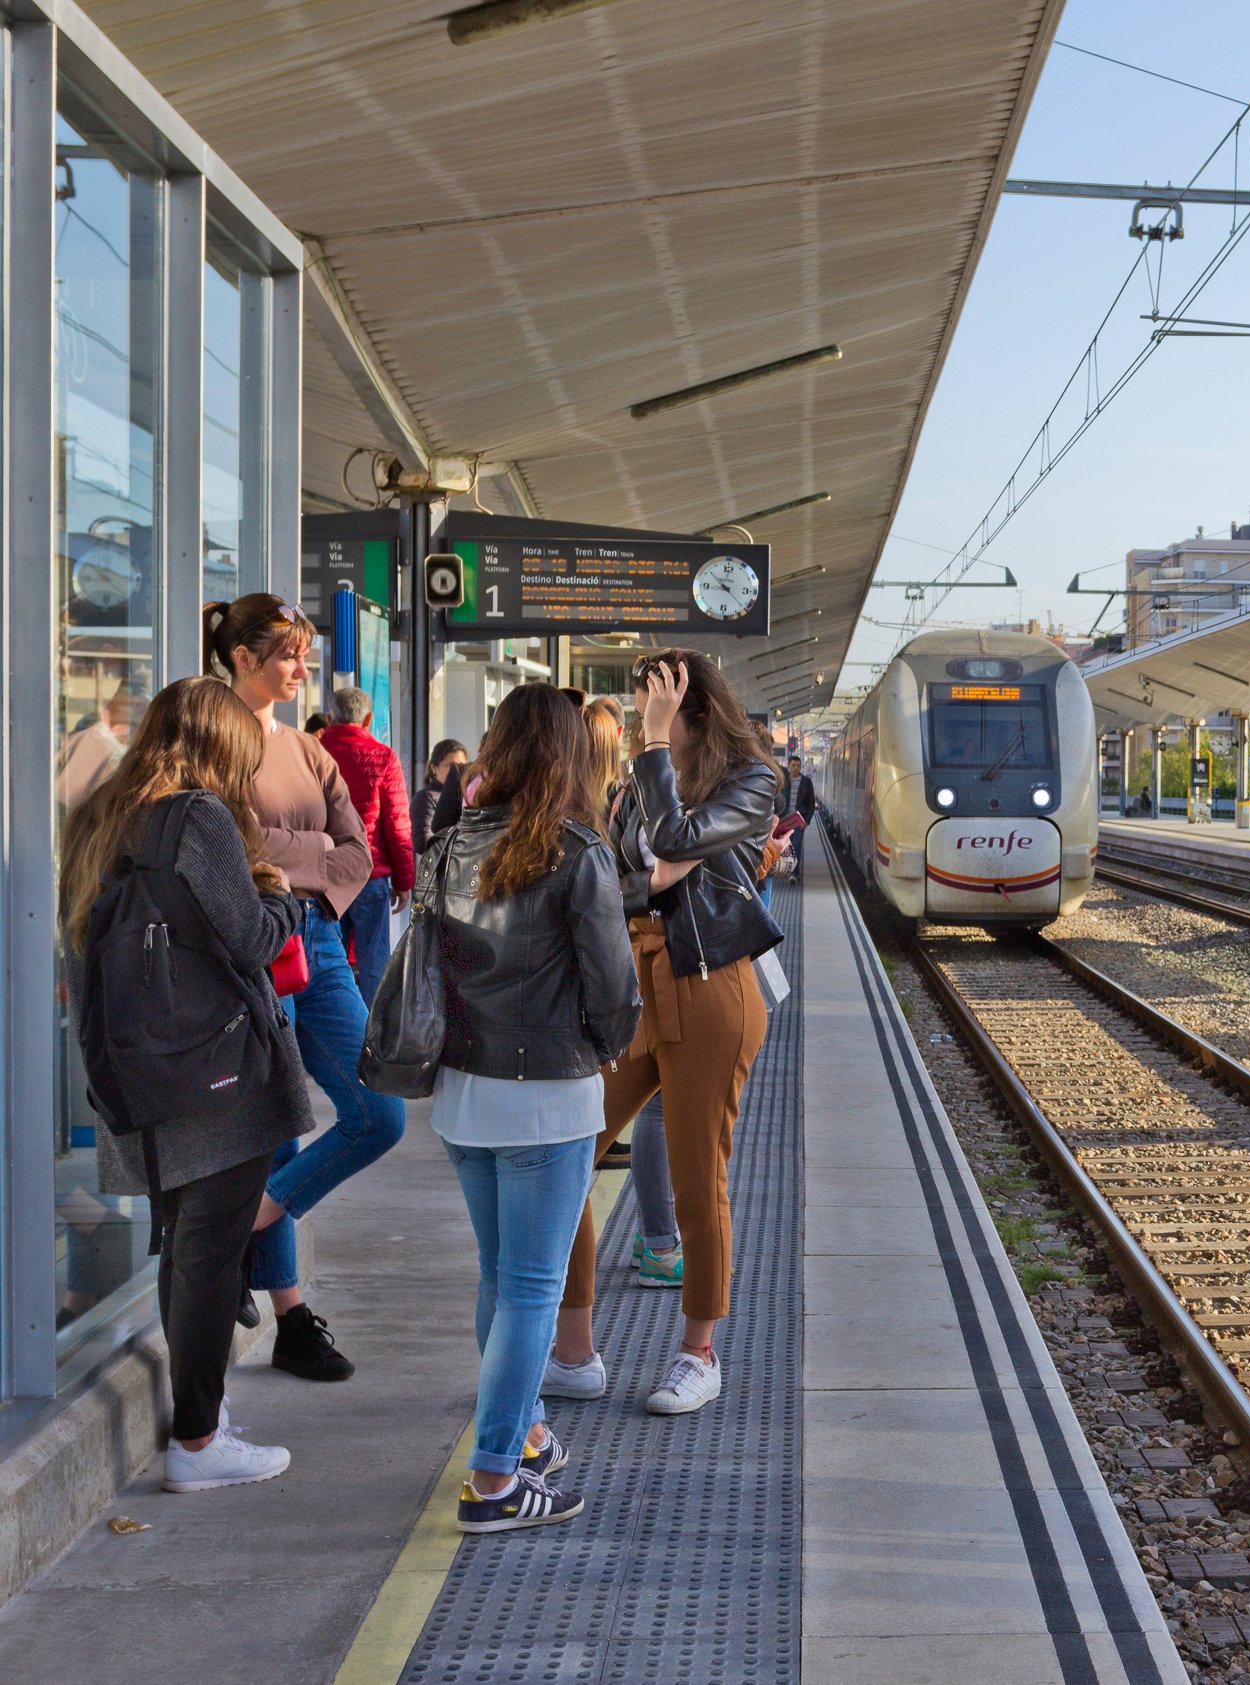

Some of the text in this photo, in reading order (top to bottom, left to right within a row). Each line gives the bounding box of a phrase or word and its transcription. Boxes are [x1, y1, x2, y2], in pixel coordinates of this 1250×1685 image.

[485, 544, 498, 554] Vía
[522, 546, 542, 556] Hora
[574, 547, 593, 556] Tren
[598, 548, 617, 557] Tren
[485, 555, 498, 565] Via
[723, 565, 734, 574] 12
[521, 574, 552, 584] Destino
[555, 574, 599, 585] Destinació
[702, 582, 710, 590] 9
[742, 586, 749, 595] 3
[485, 584, 505, 617] 1
[720, 604, 727, 612] 6
[956, 829, 1033, 856] renfe
[210, 1075, 239, 1090] EASTPAK
